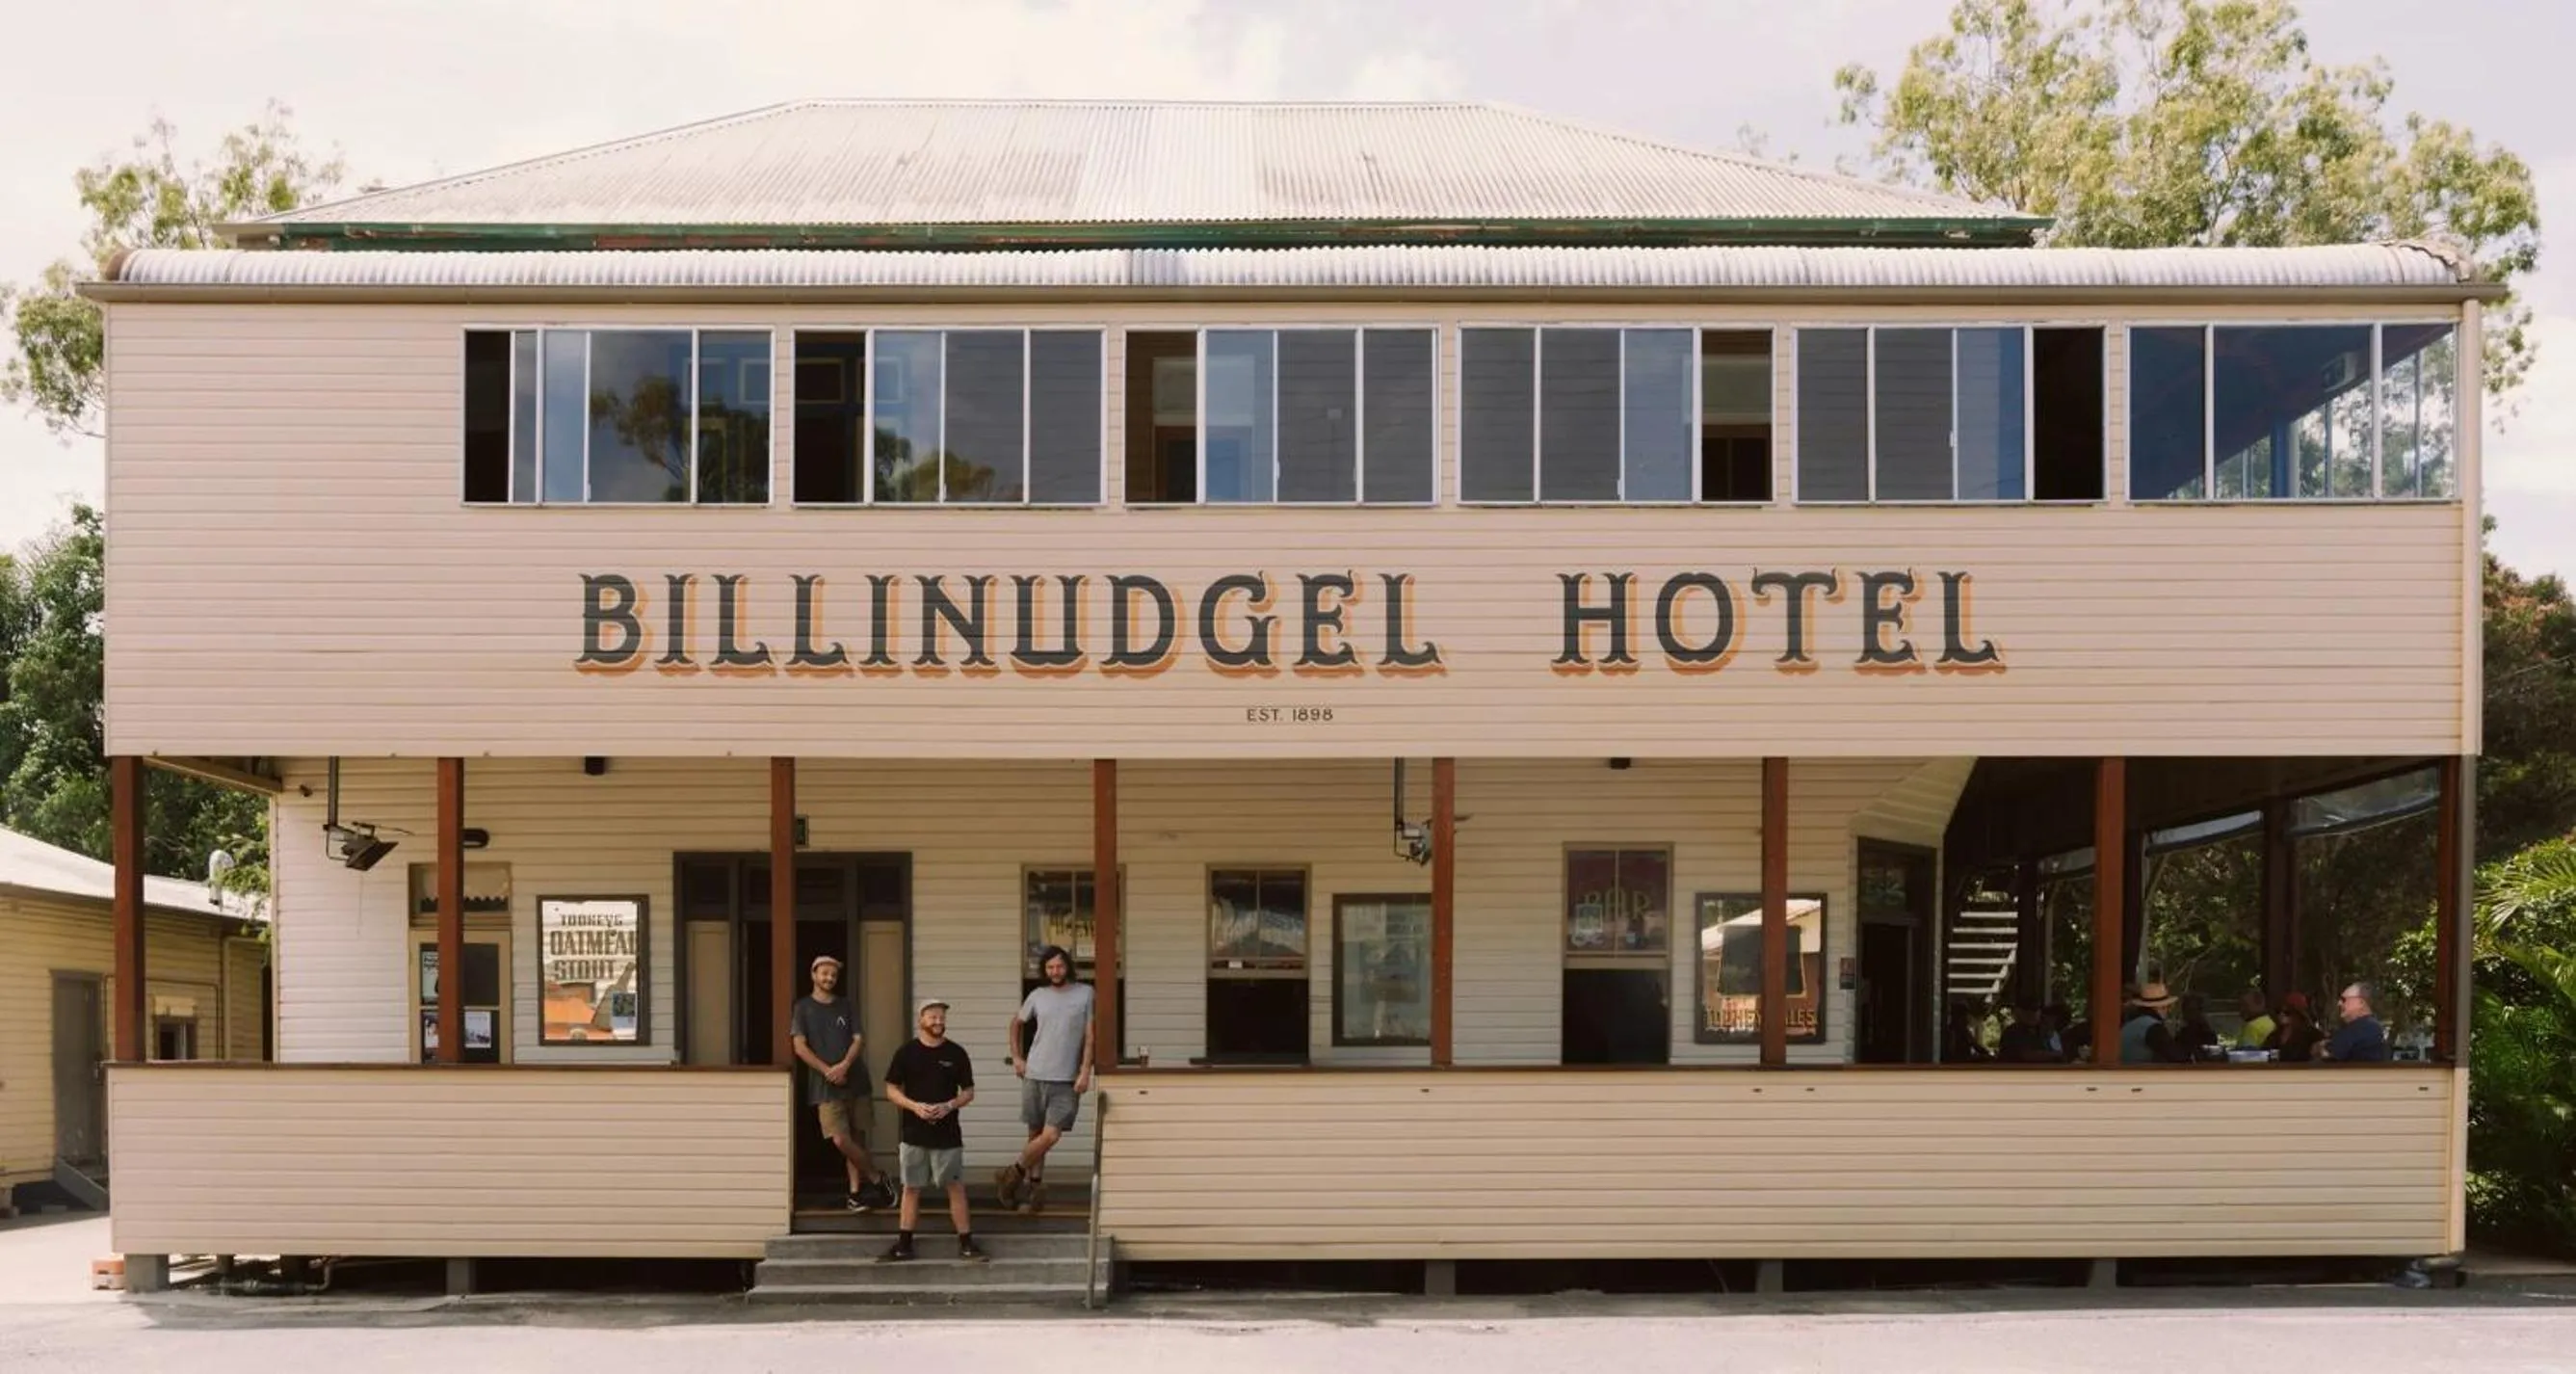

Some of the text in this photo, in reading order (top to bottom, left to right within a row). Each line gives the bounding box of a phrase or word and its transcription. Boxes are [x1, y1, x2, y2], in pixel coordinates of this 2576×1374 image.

[575, 568, 2007, 675] BILLINUDGEL HOTEL
[1247, 708, 1333, 722] EST. 1898
[553, 960, 617, 981] STOUT
[1705, 1007, 1817, 1029] TOOHEY LES
